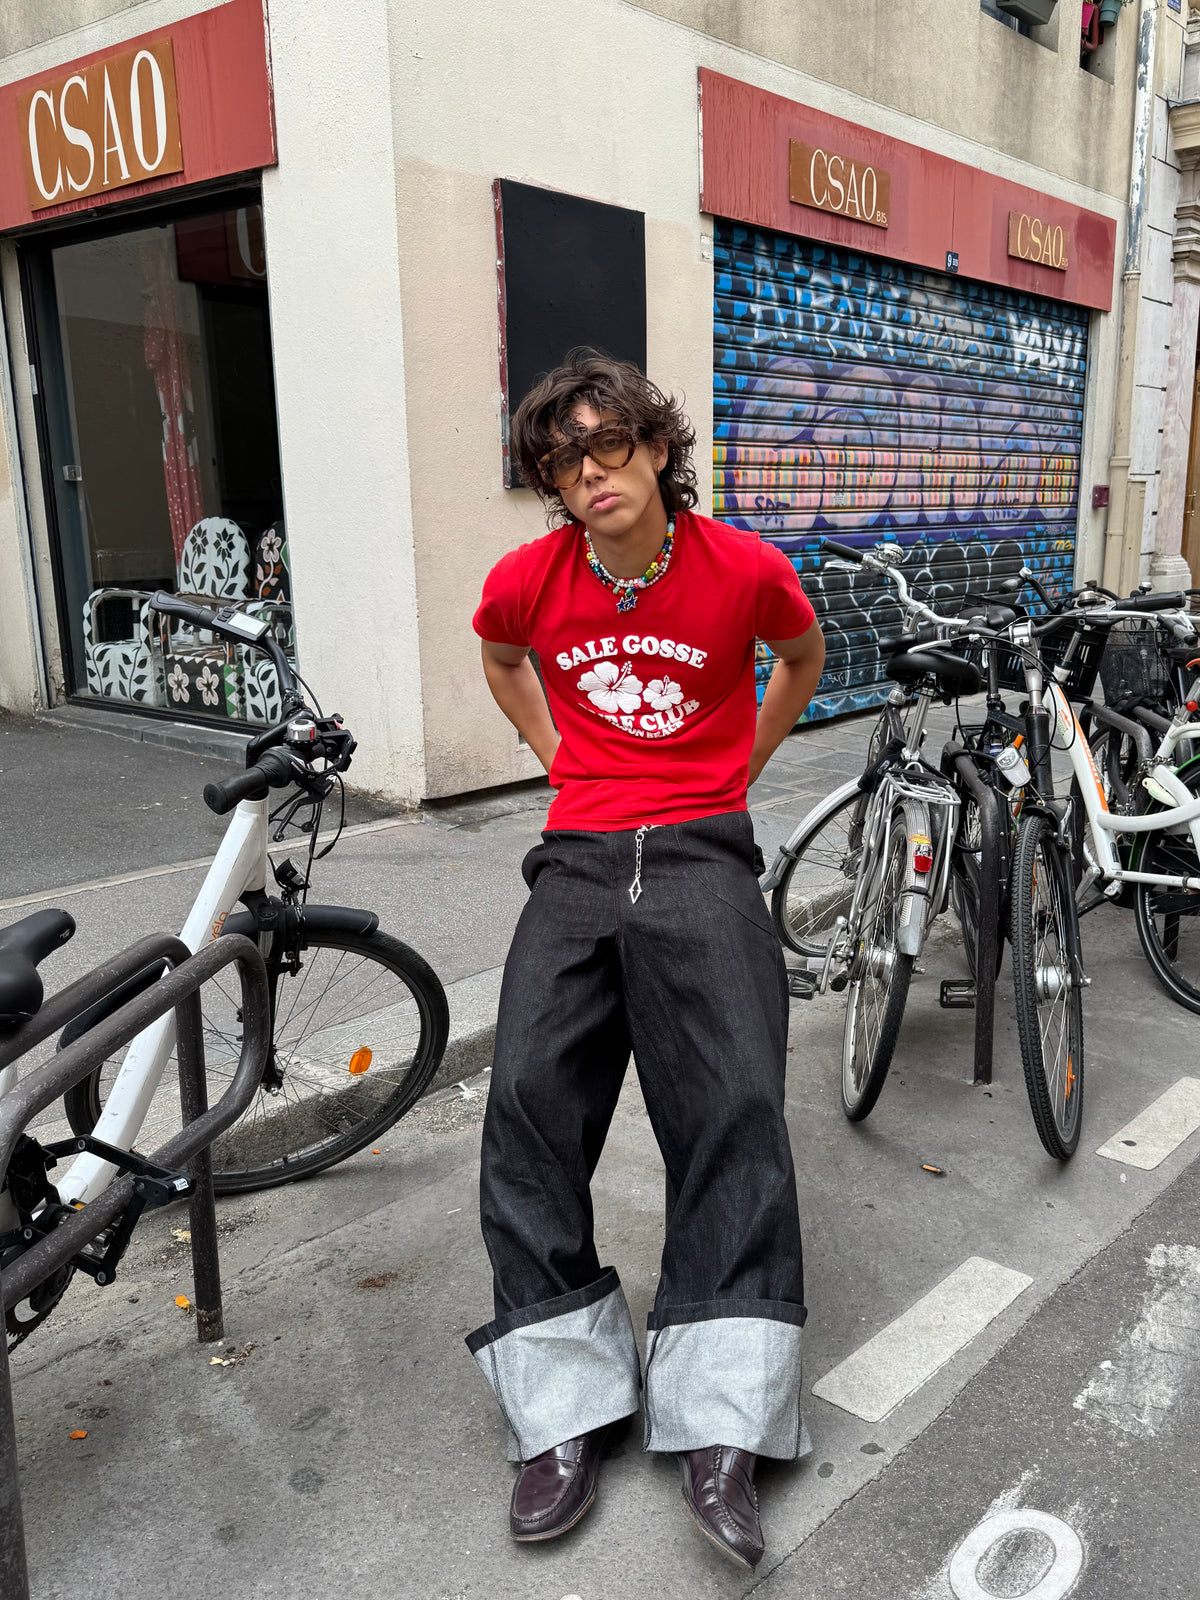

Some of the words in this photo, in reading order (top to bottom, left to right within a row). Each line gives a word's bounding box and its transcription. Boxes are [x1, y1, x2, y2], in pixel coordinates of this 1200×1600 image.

[28, 49, 168, 201] CSAO
[810, 148, 877, 220] CSAO
[947, 253, 953, 267] 9
[1017, 214, 1063, 268] CSAO
[556, 636, 618, 671] SALE
[622, 635, 708, 669] GOSSE
[640, 699, 700, 731] CLUB
